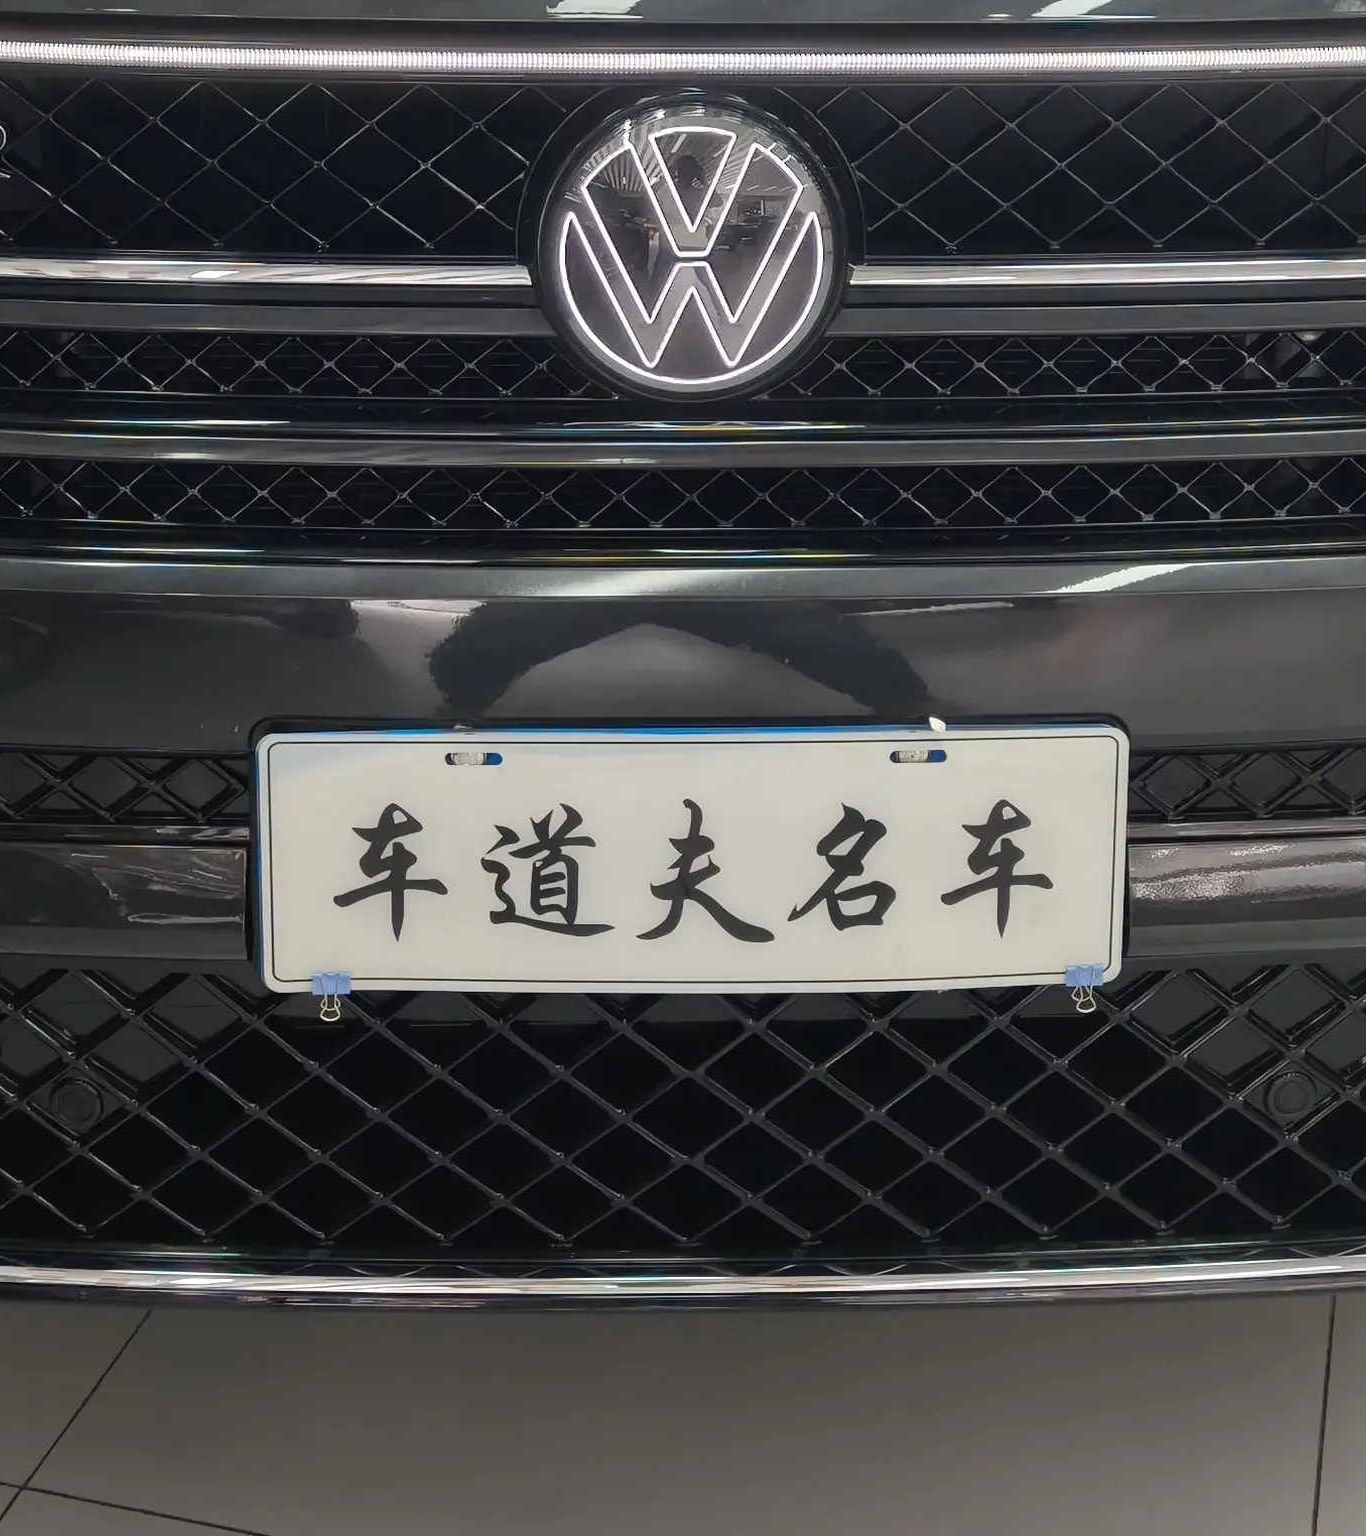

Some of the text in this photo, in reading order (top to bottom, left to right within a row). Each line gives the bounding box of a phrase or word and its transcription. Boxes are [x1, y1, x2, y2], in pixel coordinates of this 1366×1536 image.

[332, 797, 1055, 944] 车道夫名车
